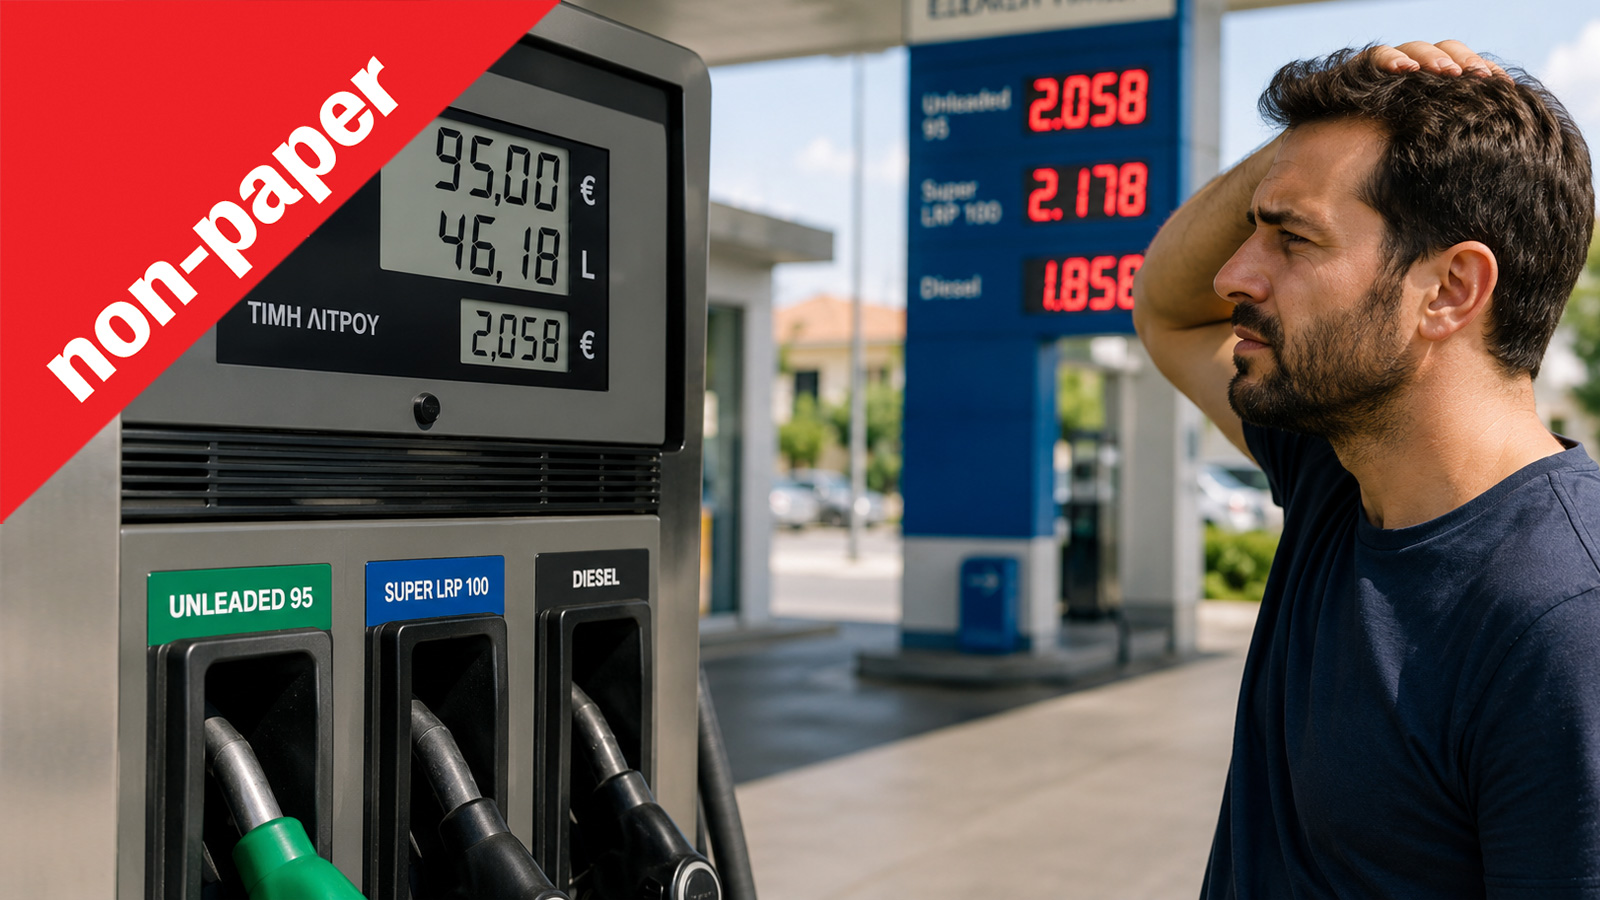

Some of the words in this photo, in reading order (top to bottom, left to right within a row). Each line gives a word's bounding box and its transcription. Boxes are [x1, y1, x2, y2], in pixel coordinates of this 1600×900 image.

[1028, 69, 1149, 132] 2.058
[435, 126, 560, 213] 95,00
[580, 175, 596, 206] €
[1028, 162, 1148, 222] 2.178
[438, 210, 560, 286] 46,18
[581, 249, 596, 280] L
[247, 300, 301, 329] ΤΙΜΗ
[307, 306, 380, 336] ΛΙΤΡΟΥ
[471, 309, 561, 364] 2,058
[579, 330, 596, 360] €
[168, 588, 286, 619] UNLEADED
[289, 586, 314, 610] 95
[384, 579, 434, 603] SUPER
[436, 578, 464, 599] LRP
[465, 576, 490, 597] 100
[572, 567, 621, 589] DIESEL
